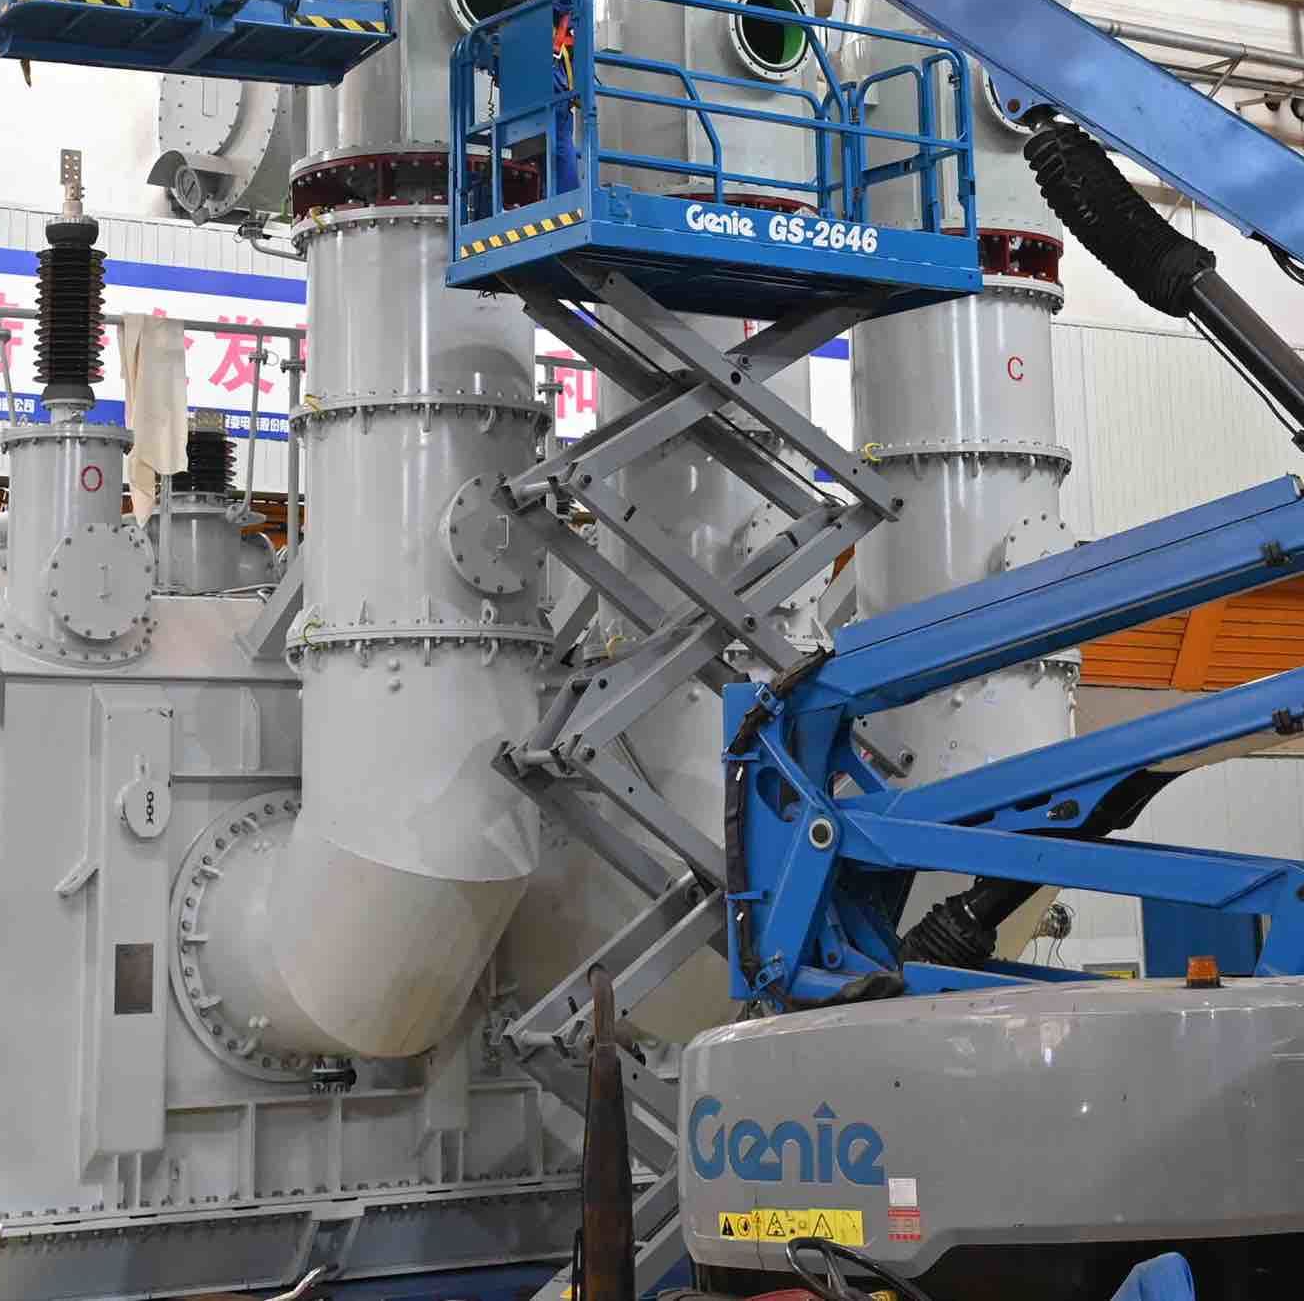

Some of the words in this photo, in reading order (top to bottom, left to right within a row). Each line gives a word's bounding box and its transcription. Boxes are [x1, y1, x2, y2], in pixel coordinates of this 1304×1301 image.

[686, 203, 756, 237] Genie
[769, 205, 878, 253] GS-2646
[1007, 356, 1024, 381] C
[688, 1095, 886, 1186] Genie
